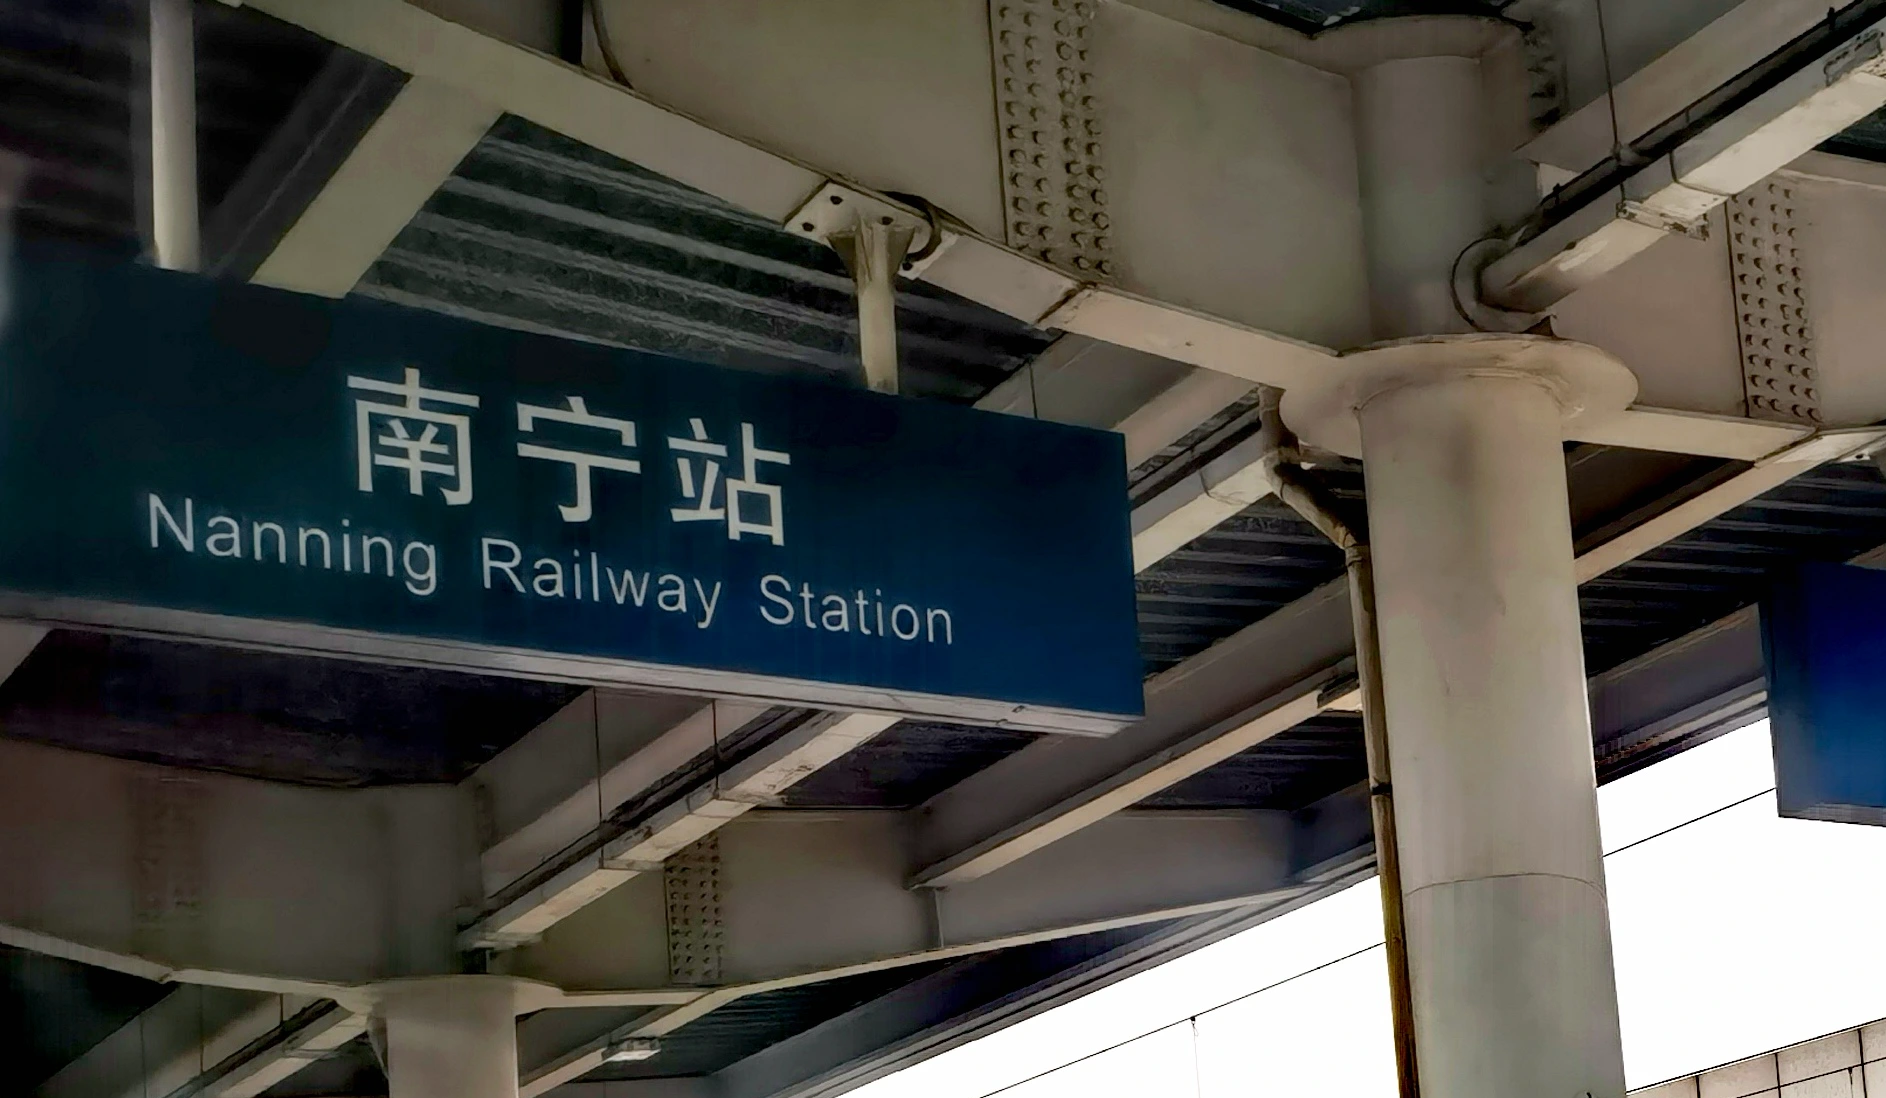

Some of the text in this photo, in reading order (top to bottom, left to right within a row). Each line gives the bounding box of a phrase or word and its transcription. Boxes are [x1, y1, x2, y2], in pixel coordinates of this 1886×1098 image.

[347, 368, 791, 547] 南宁站
[148, 493, 955, 645] Nanning Railway Station
